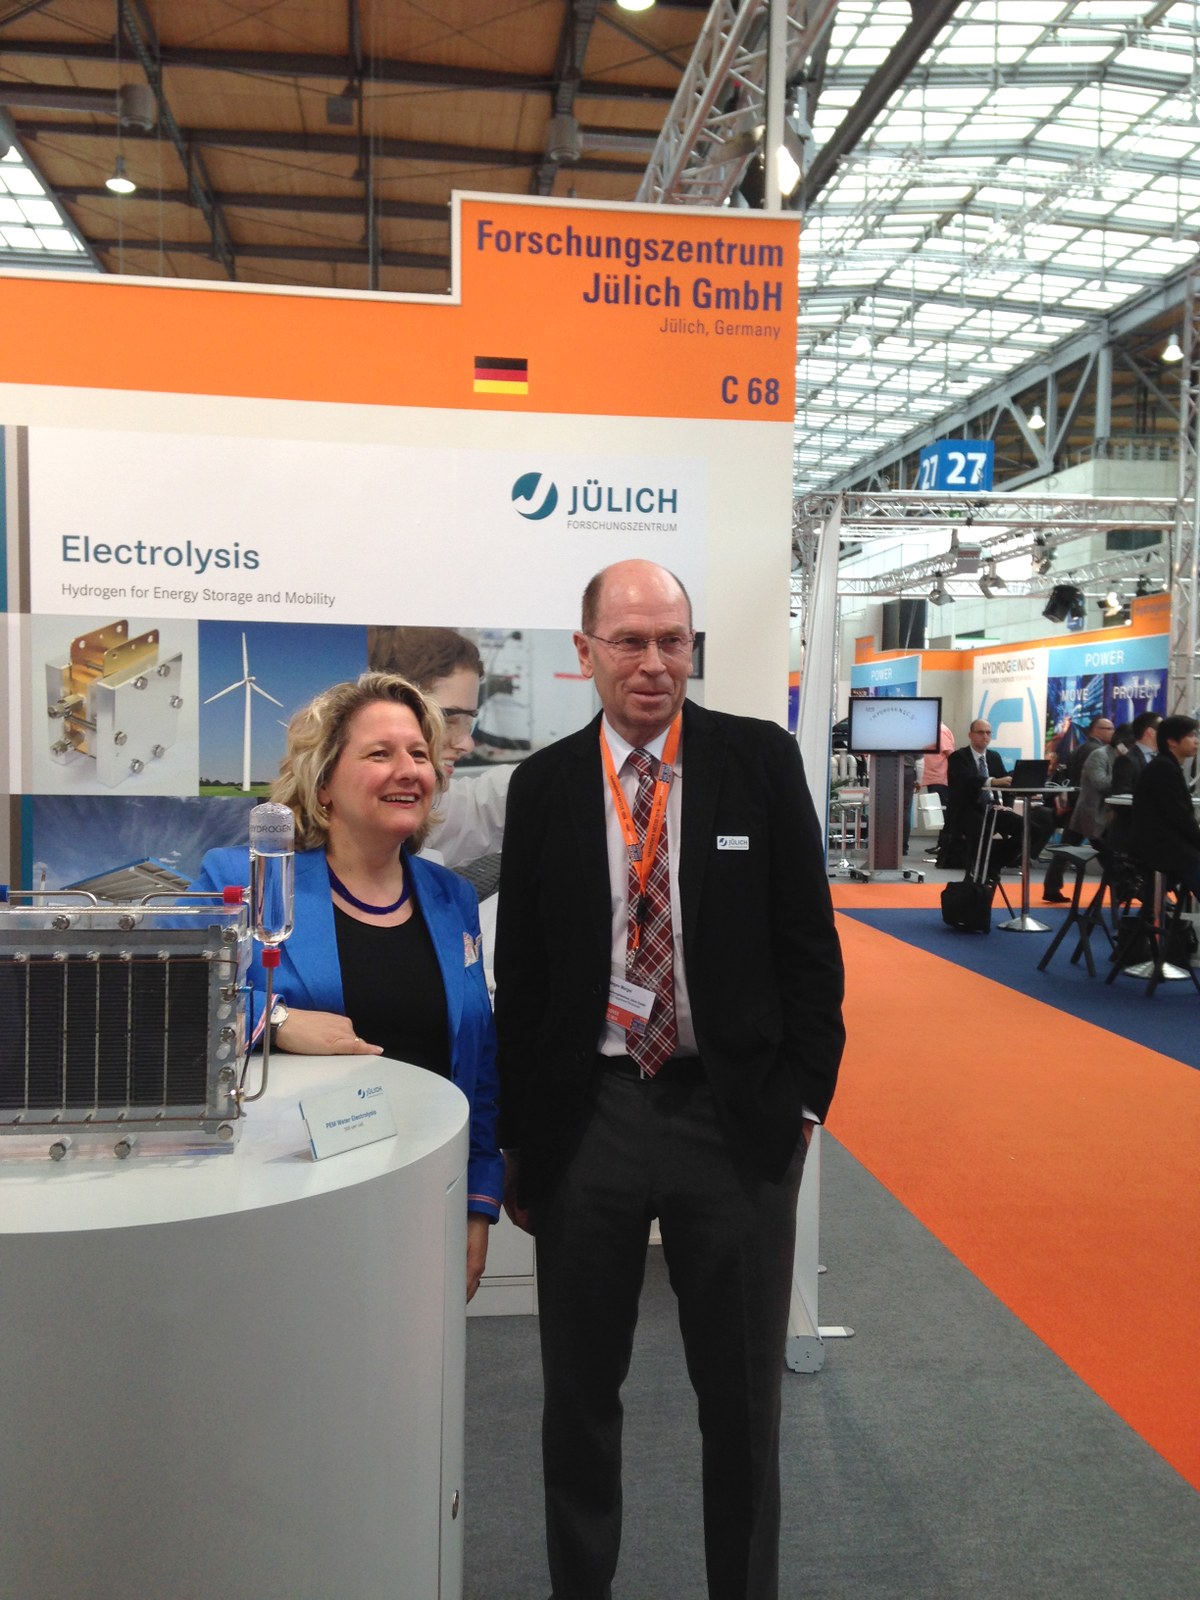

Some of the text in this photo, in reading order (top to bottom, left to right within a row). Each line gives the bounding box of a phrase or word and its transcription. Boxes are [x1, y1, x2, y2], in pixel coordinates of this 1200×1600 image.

[477, 219, 784, 268] Forschungszentrum
[583, 272, 783, 312] Jülich GmbH
[659, 318, 781, 341] Jülich, Germany
[721, 375, 780, 405] C 68
[946, 451, 987, 485] 27
[568, 479, 678, 516] JÜLICH
[567, 520, 678, 532] FORSCHUNGSZENTRUM
[61, 534, 260, 574] Electrolysis
[61, 583, 336, 608] Hydrogen for Energy Storage and Mobility
[982, 657, 1035, 675] HYDROGENICS
[1085, 650, 1125, 667] POWER
[871, 668, 892, 680] POWER
[1112, 684, 1161, 700] PROTECT
